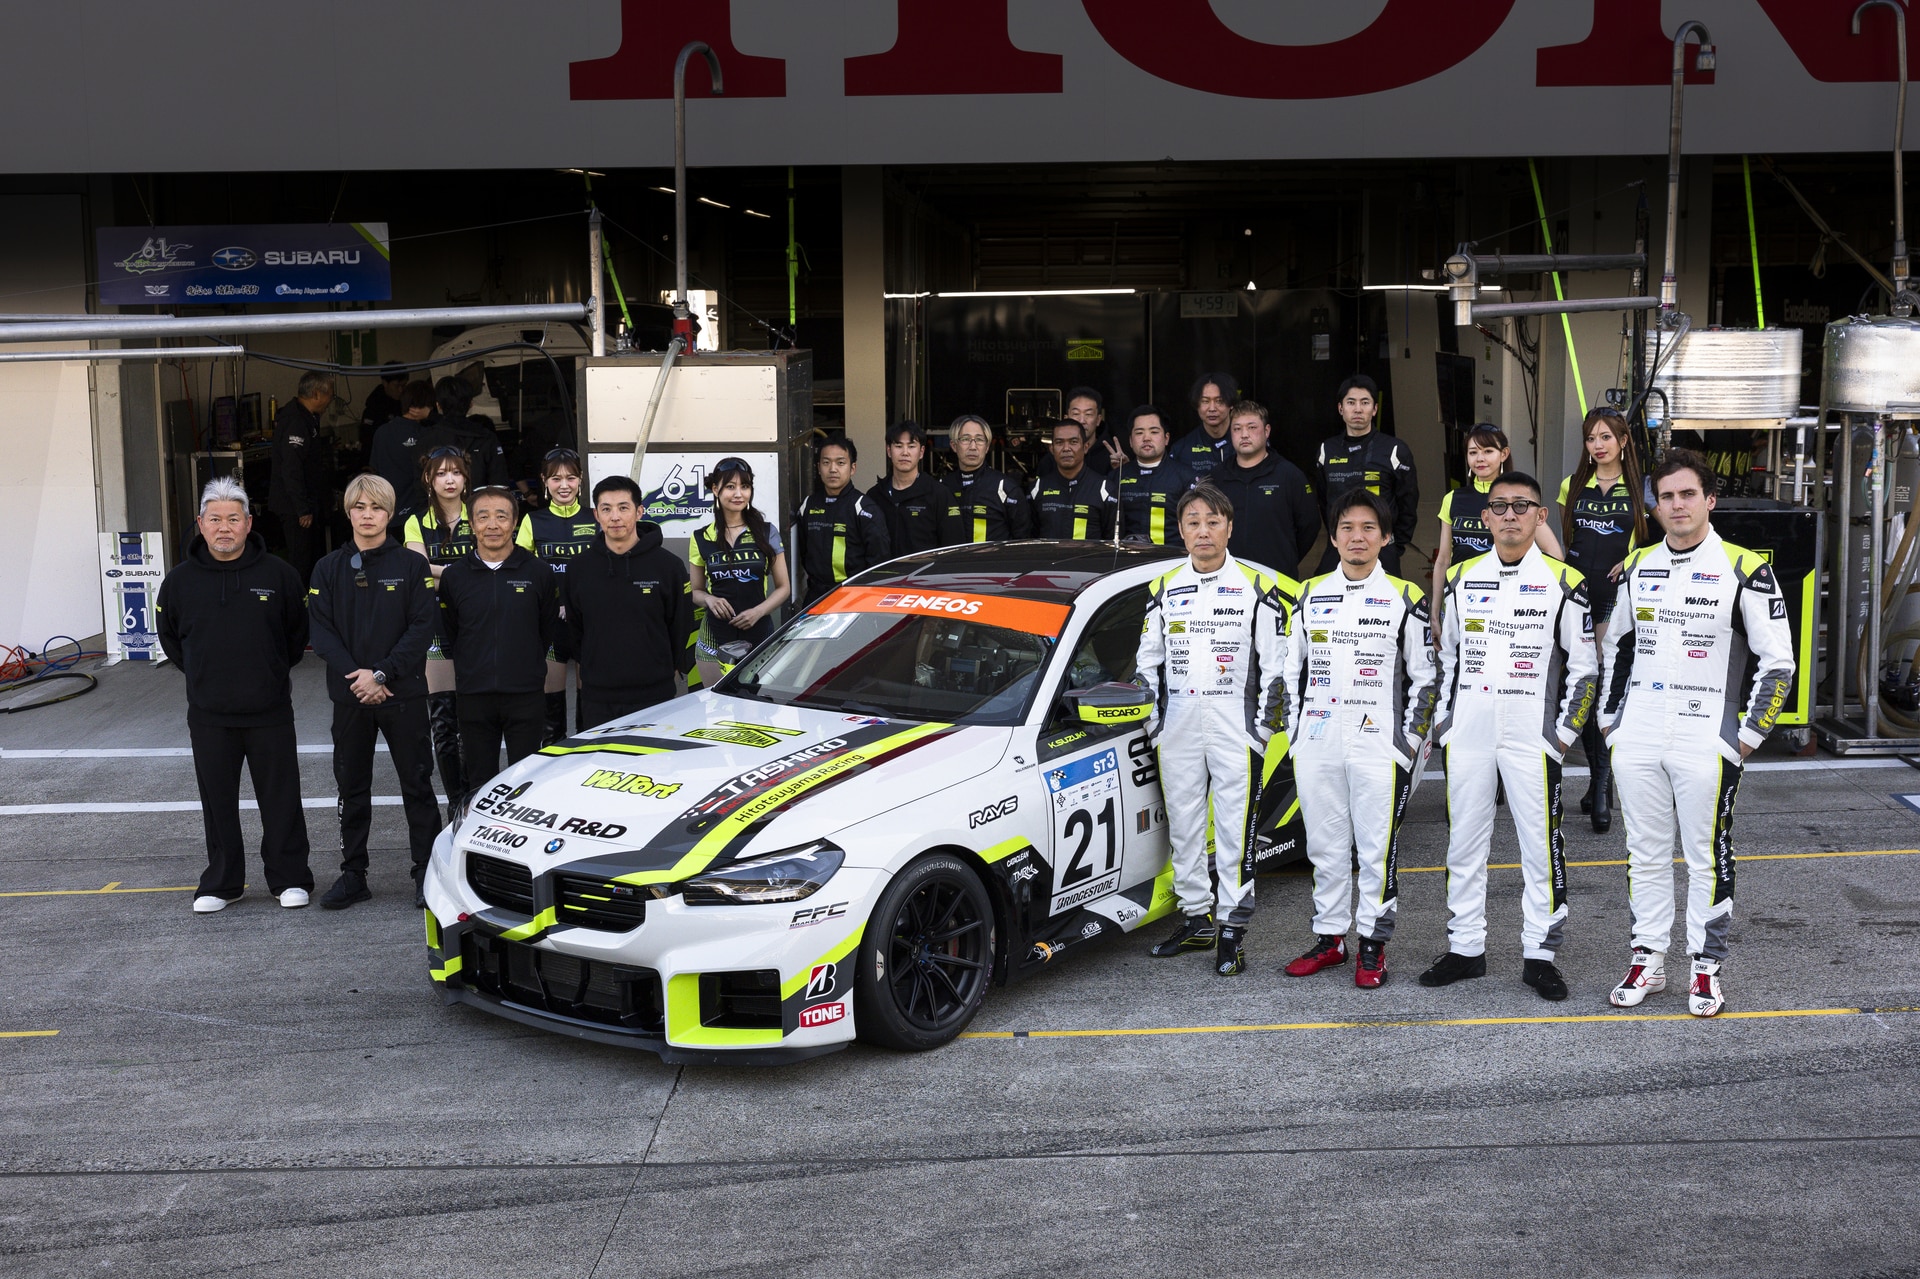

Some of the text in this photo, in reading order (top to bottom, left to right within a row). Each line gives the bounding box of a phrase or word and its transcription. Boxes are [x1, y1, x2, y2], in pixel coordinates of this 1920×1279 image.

[142, 237, 167, 258] 61
[265, 251, 360, 264] SUBARU
[1784, 299, 1830, 323] Excellence
[967, 339, 1058, 352] Hitotsuyama
[967, 352, 1014, 363] Racing
[656, 464, 705, 500] 61
[1588, 502, 1629, 513] GAIA
[1576, 518, 1615, 529] TMRM
[1453, 536, 1488, 546] TMRM
[722, 552, 760, 562] GAIA
[1671, 557, 1691, 566] freem
[712, 568, 751, 580] TMRM
[1200, 575, 1218, 585] freem
[1499, 570, 1518, 579] freem
[1346, 584, 1364, 592] freem
[1752, 580, 1771, 590] freem
[896, 594, 983, 614] ENEOS
[122, 607, 149, 629] 61
[1659, 608, 1715, 620] Hitotsuyama
[1190, 620, 1242, 631] Hitotsuyama
[1489, 620, 1544, 631] Hitotsuyama
[1658, 616, 1686, 626] Racing
[1190, 627, 1216, 635] Racing
[1333, 631, 1387, 641] Hitotsuyama
[1488, 628, 1515, 638] Racing
[1332, 636, 1359, 646] Racing
[1172, 666, 1188, 676] Bulky
[1353, 679, 1383, 688] Imikoto
[1669, 684, 1707, 692] S.WALKINSHAW
[1573, 682, 1595, 728] freem
[1759, 680, 1788, 730] freem
[1097, 708, 1140, 718] RECARO
[1048, 731, 1087, 749] K.SUZUKI
[718, 738, 848, 795] TASHIRO
[1093, 751, 1116, 774] ST3
[734, 753, 865, 823] Hitotsuyama Racing
[717, 787, 761, 815] Machine
[1552, 783, 1560, 816] Racing
[1720, 785, 1734, 817] Racing
[969, 795, 1018, 829] RAYS
[491, 801, 628, 839] SHIBA R&D
[473, 825, 528, 848] TAKMO
[1061, 797, 1116, 889] 21
[470, 839, 485, 848] RACING
[485, 843, 501, 852] MOTOR
[1255, 838, 1296, 863] Motorsport
[1006, 850, 1029, 868] CATACLEAN
[1552, 829, 1564, 889] Hitotsuyama
[1055, 877, 1116, 911] BRIDGESTONE
[791, 901, 849, 924] PFC
[1116, 908, 1139, 923] Bulky
[790, 919, 819, 927] BRAKES
[803, 1004, 842, 1025] TONE
